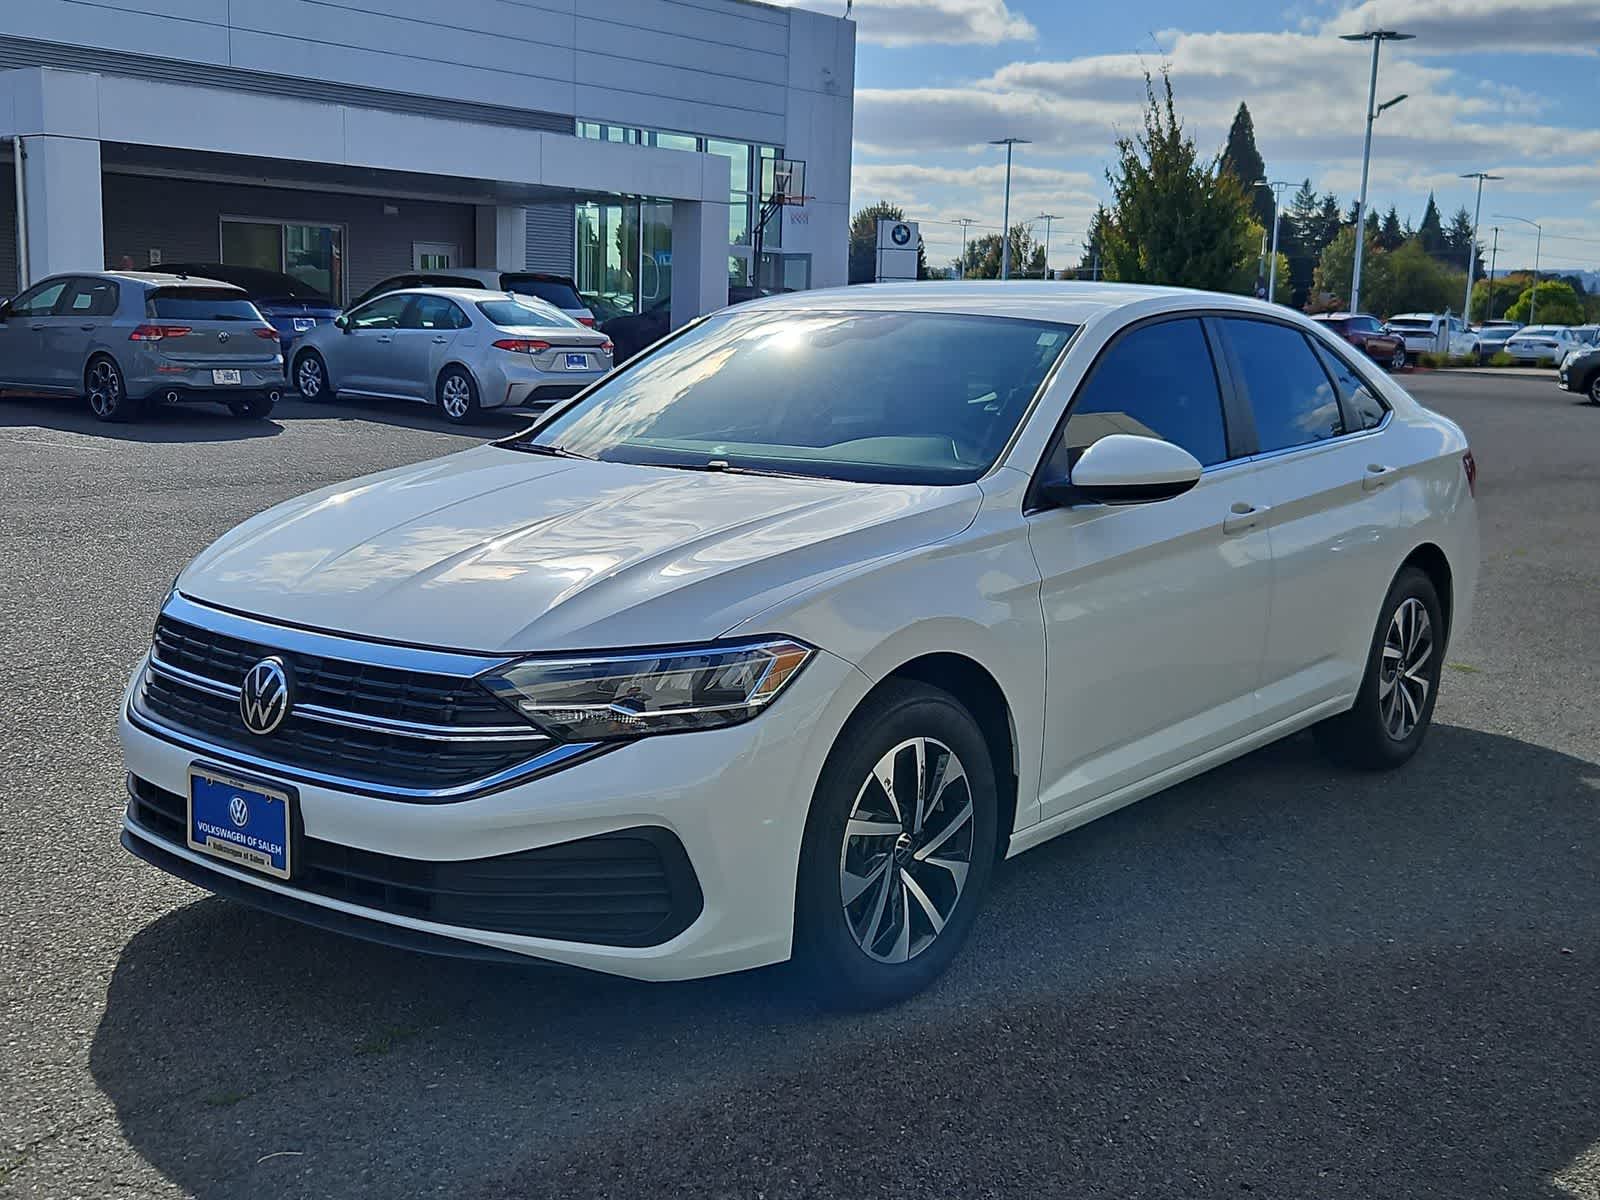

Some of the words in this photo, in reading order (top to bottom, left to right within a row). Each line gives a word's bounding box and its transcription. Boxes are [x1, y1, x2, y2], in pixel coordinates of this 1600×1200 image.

[198, 820, 246, 844] VOLKSWAGEN
[247, 836, 257, 847] OF
[258, 839, 282, 856] SALEM
